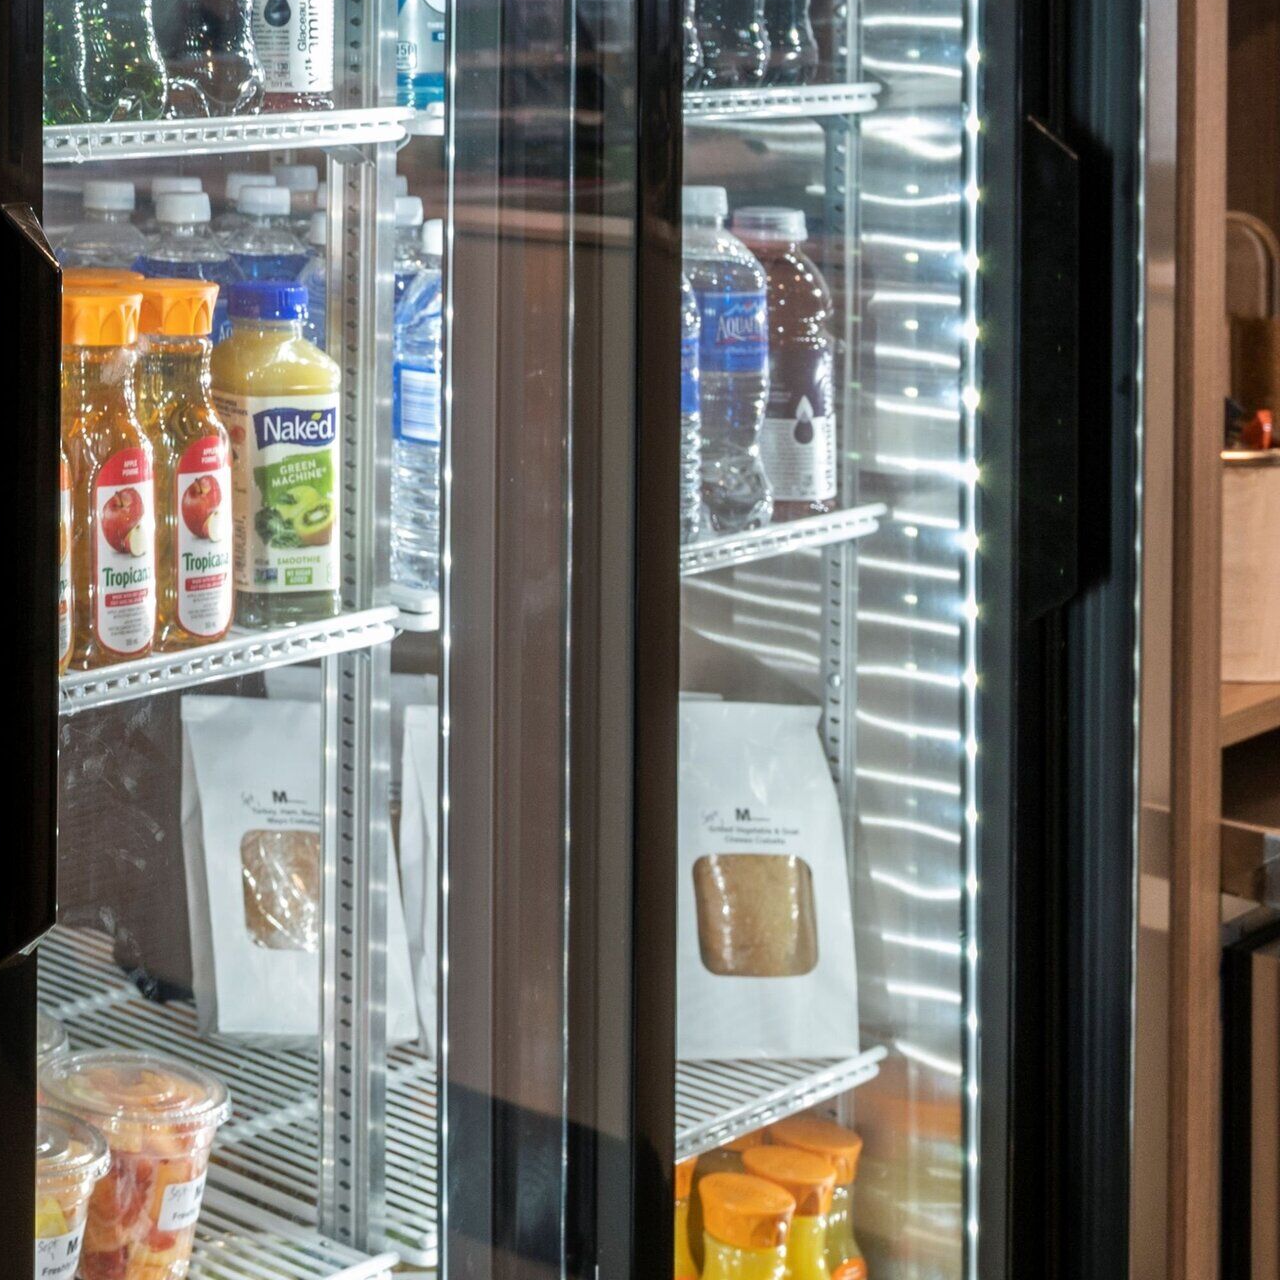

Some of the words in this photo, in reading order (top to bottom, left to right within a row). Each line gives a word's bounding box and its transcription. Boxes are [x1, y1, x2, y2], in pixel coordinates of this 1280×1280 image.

[279, 459, 317, 476] GREEN
[271, 468, 323, 488] MACHINE
[277, 555, 321, 565] SMOOTHIE
